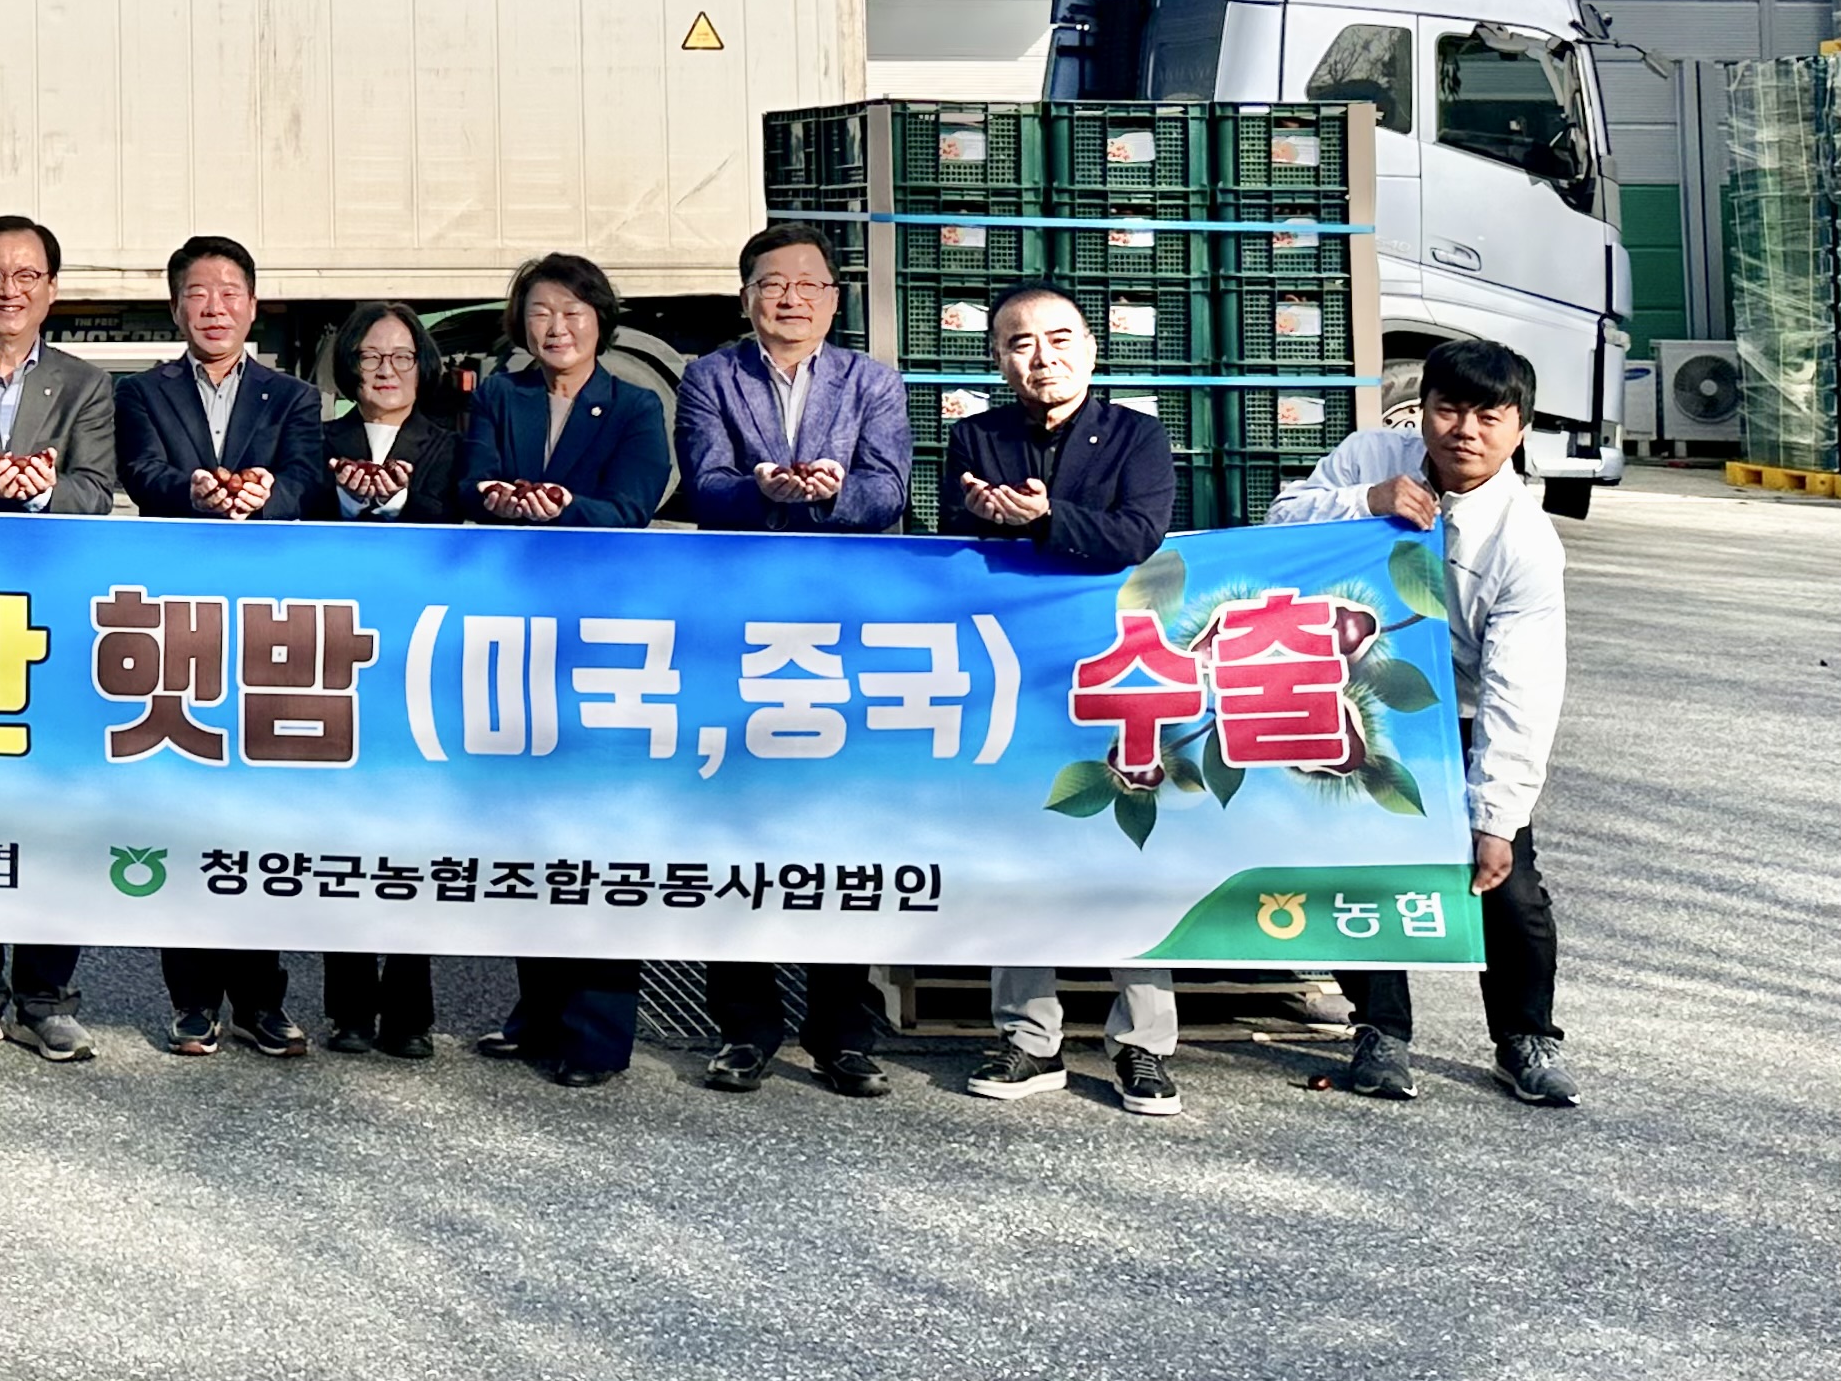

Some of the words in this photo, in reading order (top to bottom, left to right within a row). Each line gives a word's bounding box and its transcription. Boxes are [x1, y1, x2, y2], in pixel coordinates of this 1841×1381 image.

[90, 585, 380, 768] 햇밤
[405, 605, 1022, 780] (미국,중국)
[1068, 588, 1350, 772] 수출
[200, 848, 943, 913] 청양군농협조합공동사업법인
[1332, 890, 1447, 939] 농협
